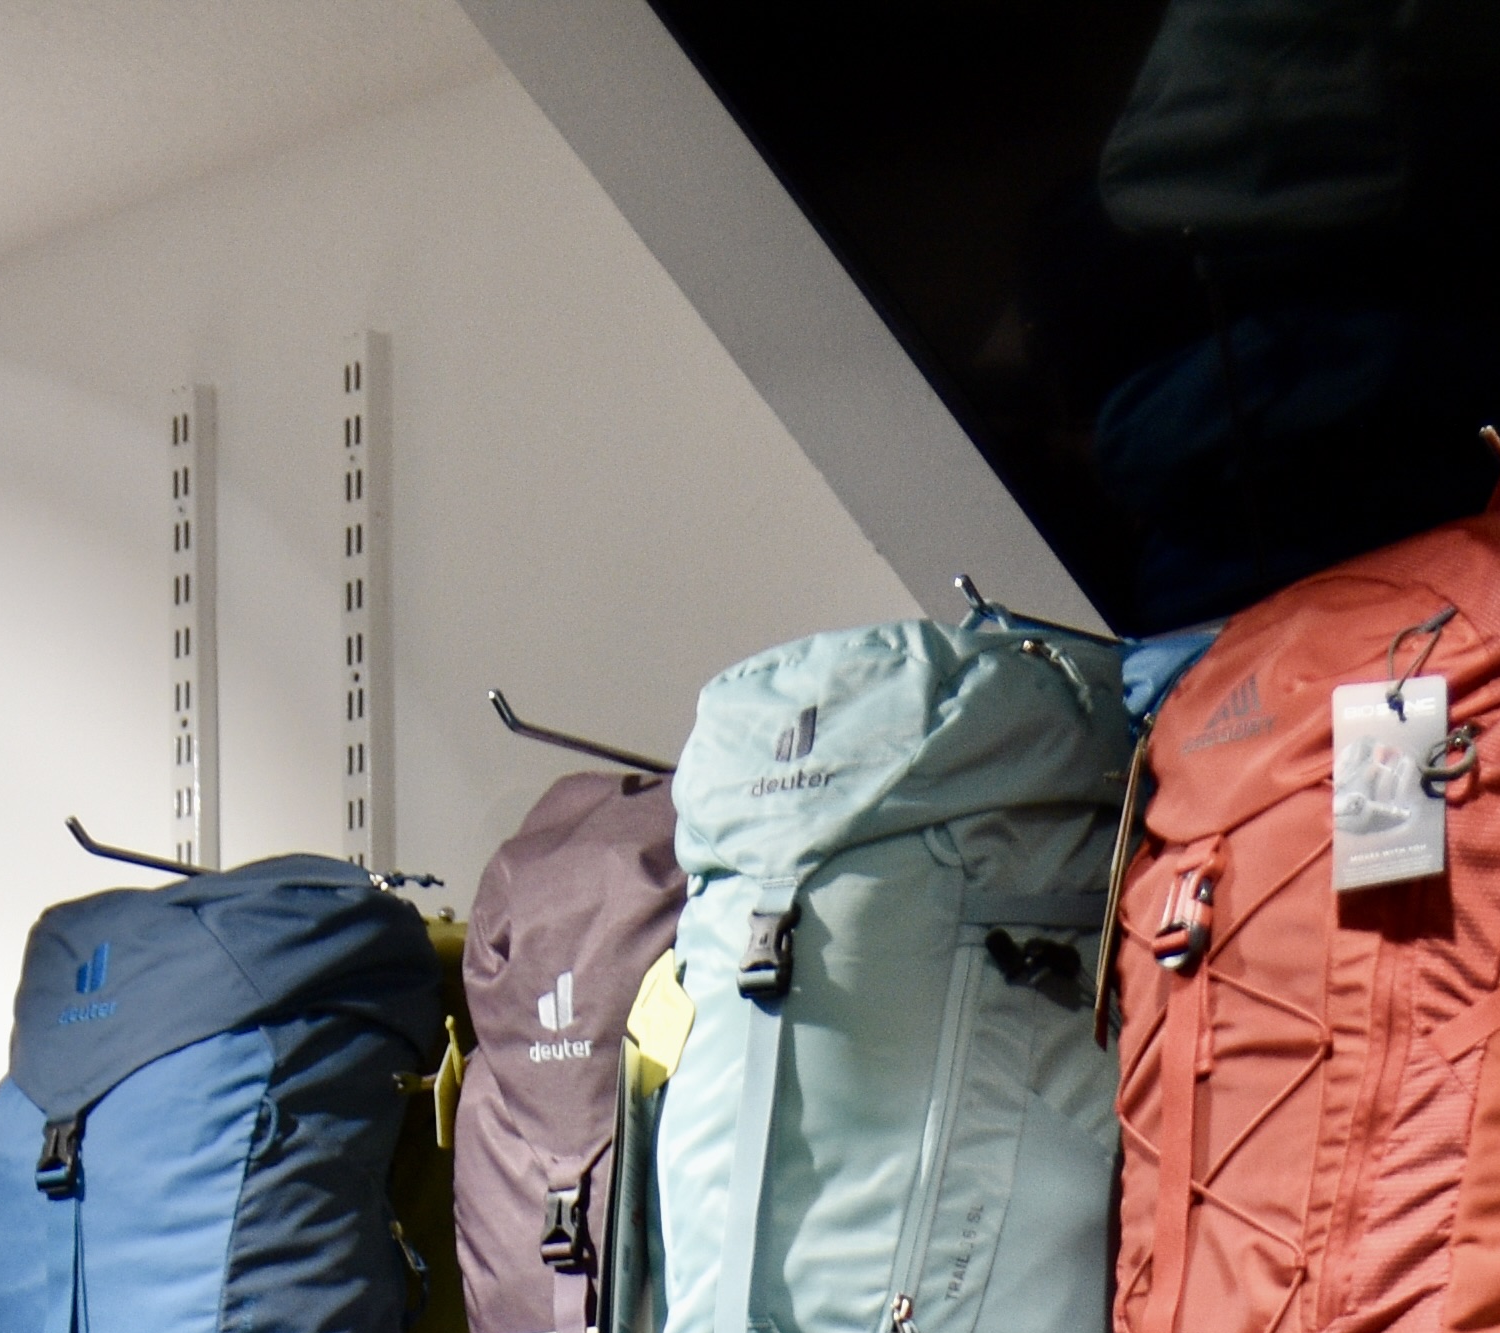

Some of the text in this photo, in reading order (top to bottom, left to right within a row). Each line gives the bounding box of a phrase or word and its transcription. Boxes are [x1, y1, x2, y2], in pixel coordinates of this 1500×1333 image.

[750, 769, 835, 798] deuter
[529, 1036, 594, 1063] deuter
[944, 1254, 971, 1301] TRAIL
[966, 1204, 984, 1224] SL
